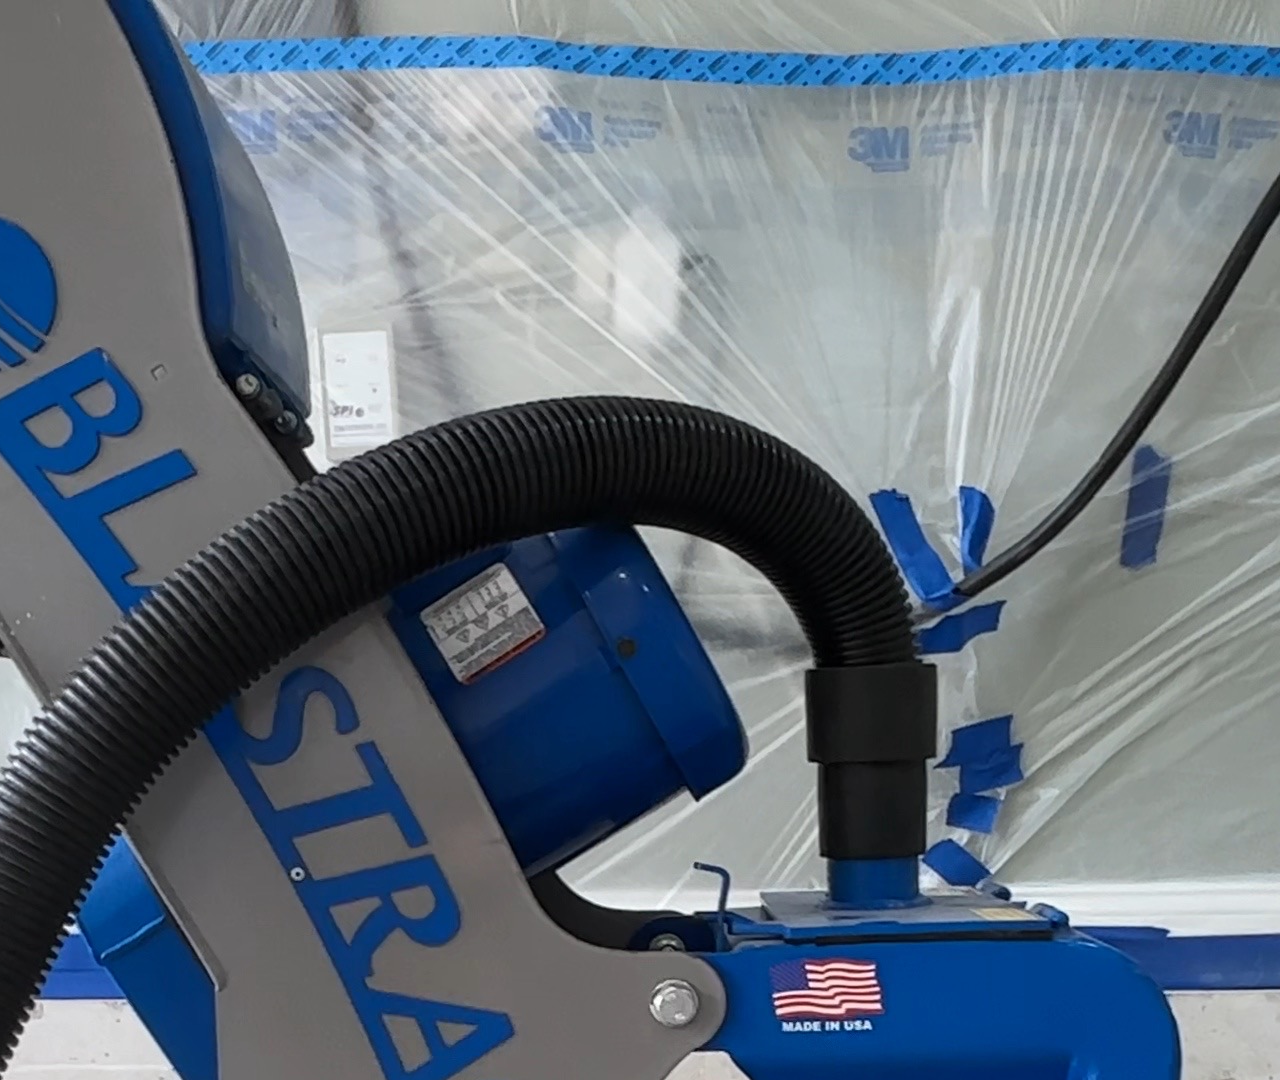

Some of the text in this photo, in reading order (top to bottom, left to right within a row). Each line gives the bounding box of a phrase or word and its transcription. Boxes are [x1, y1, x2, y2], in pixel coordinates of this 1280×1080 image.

[847, 126, 910, 162] 3M
[1163, 110, 1222, 147] 3M
[782, 1020, 873, 1032] MADE IN USA
